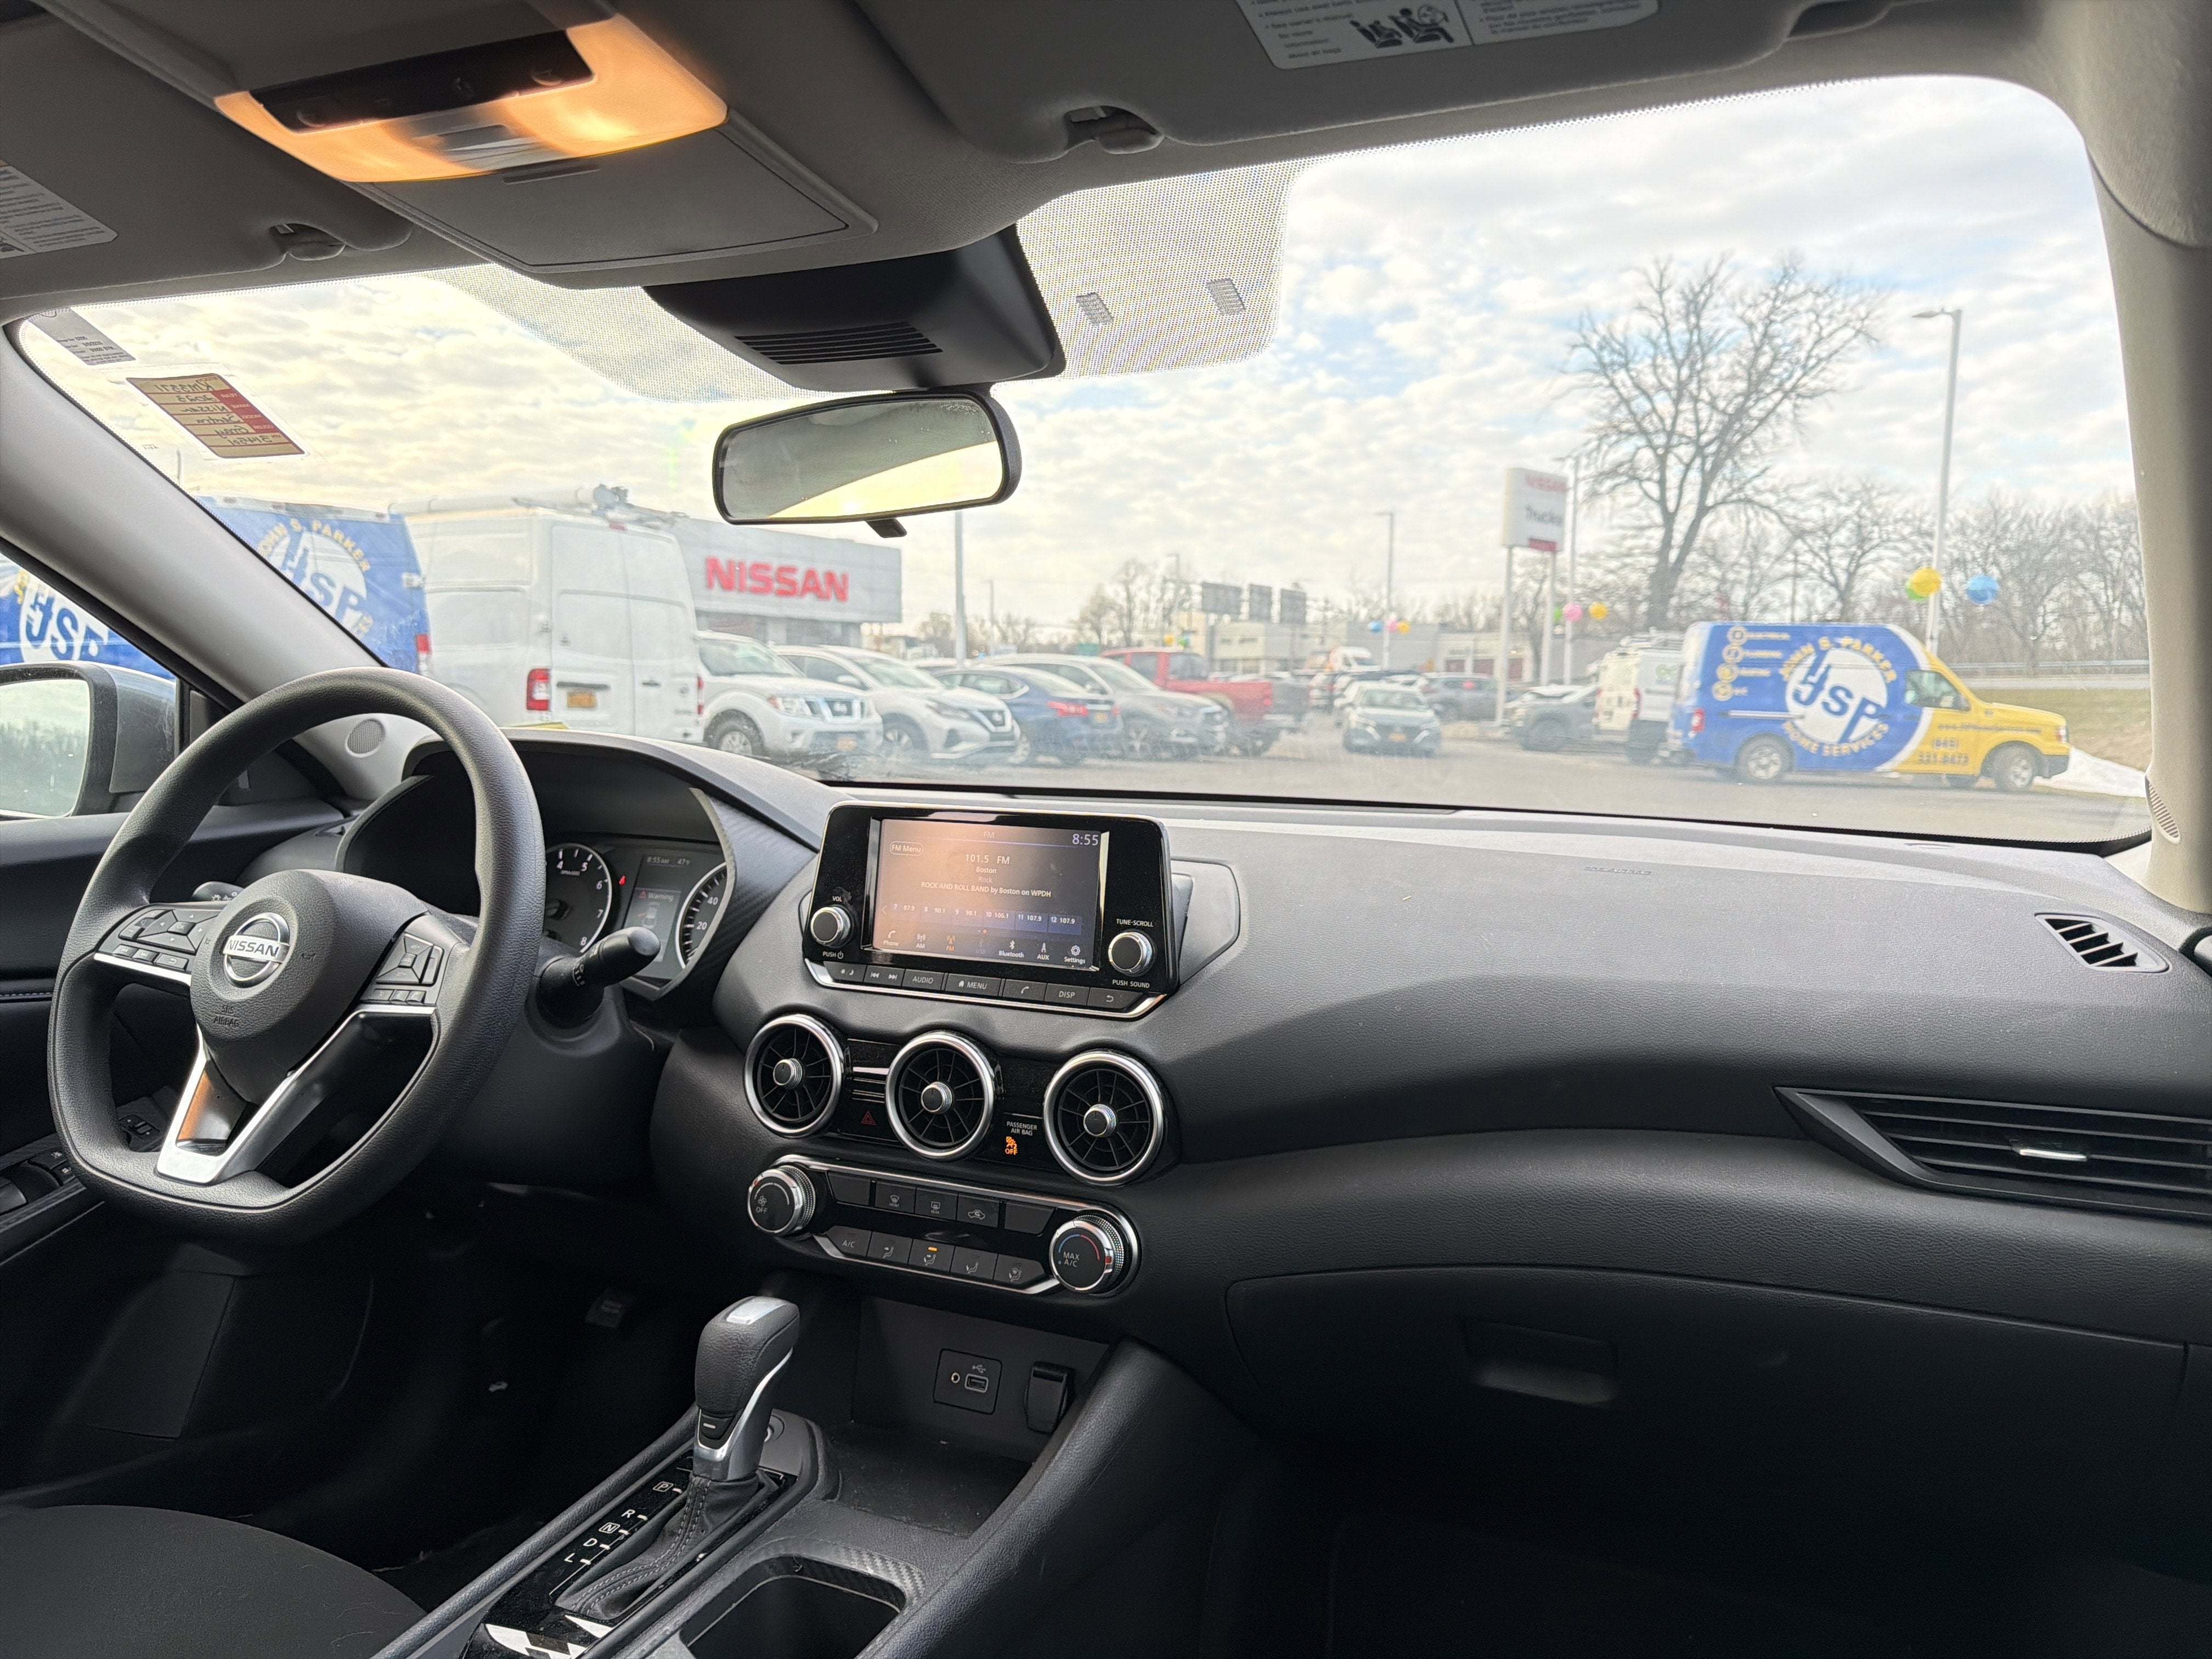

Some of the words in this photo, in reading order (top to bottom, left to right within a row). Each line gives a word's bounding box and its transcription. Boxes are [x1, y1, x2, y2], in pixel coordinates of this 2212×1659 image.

[312, 519, 371, 572] PARKER
[706, 555, 849, 602] NISSAN
[1072, 833, 1099, 845] 8:55
[966, 854, 989, 864] 101.5
[997, 855, 1010, 865] FM
[556, 860, 563, 869] 4
[581, 862, 588, 871] 5
[596, 880, 603, 889] 6
[648, 891, 674, 902] Warning
[990, 886, 998, 895] by
[999, 887, 1020, 895] Boston
[1031, 889, 1052, 898] WPDH
[707, 896, 719, 905] 40
[597, 909, 603, 918] 7
[696, 921, 708, 930] 20
[580, 936, 588, 946] 8
[226, 939, 280, 957] NISSAN
[1064, 956, 1086, 965] Settings
[912, 975, 933, 984] AUDIO
[967, 981, 988, 990] MENU
[1007, 1121, 1037, 1130] PASSENGER
[842, 1240, 855, 1249] A/C
[1063, 1251, 1080, 1261] MAX
[1064, 1259, 1077, 1267] A/C
[621, 1509, 636, 1519] R
[583, 1538, 598, 1547] D
[564, 1553, 575, 1562] L
